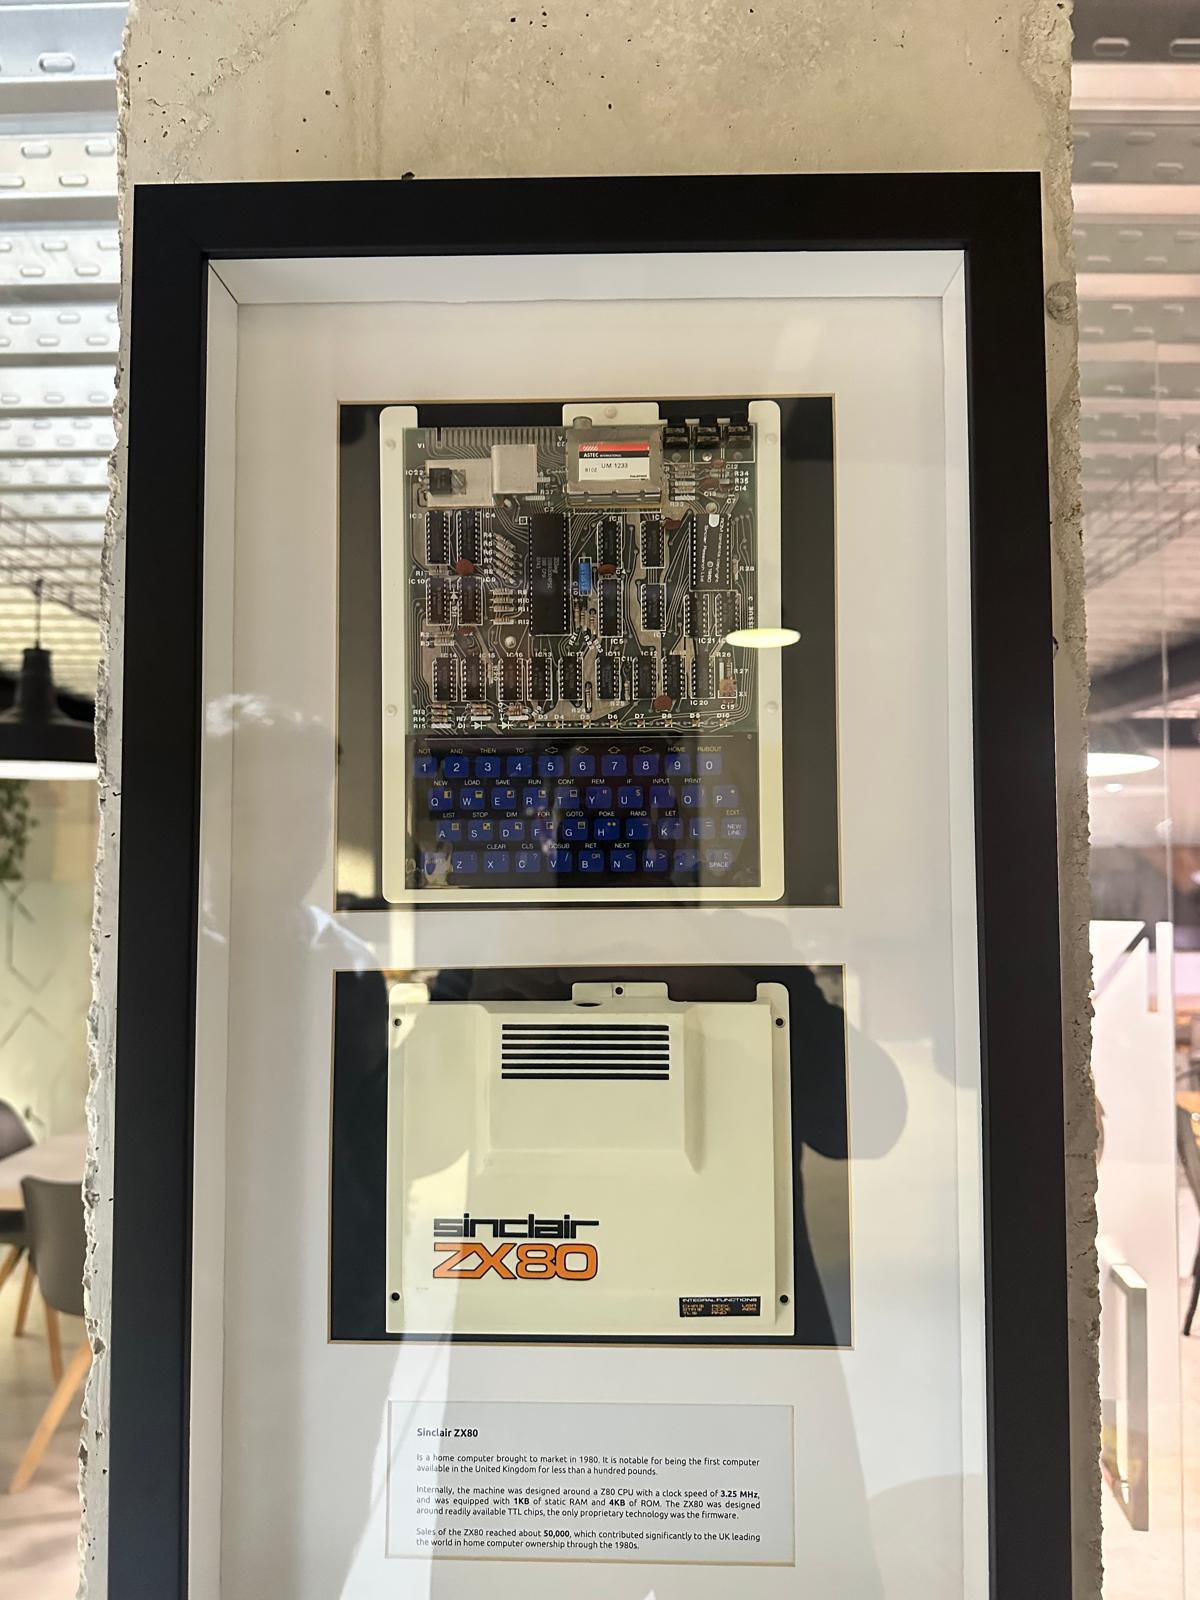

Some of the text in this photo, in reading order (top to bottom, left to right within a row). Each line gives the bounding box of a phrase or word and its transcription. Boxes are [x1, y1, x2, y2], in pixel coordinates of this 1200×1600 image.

[453, 763, 460, 772] 2
[484, 762, 491, 772] 3
[515, 763, 522, 771] 4
[547, 762, 554, 771] 5
[580, 762, 586, 770] 6
[612, 762, 618, 770] 7
[642, 761, 649, 770] 8
[674, 761, 680, 770] 9
[431, 796, 628, 806] Q W E R U
[471, 830, 478, 838] S
[565, 828, 572, 837] G
[597, 828, 604, 836] H
[582, 860, 588, 868] B
[433, 1213, 599, 1238] sinclair
[433, 1242, 598, 1281] ZX80
[417, 1428, 478, 1438] Sinclair ZX80
[457, 1455, 494, 1464] computer
[496, 1454, 528, 1464] brought
[540, 1456, 568, 1464] market
[618, 1456, 649, 1465] notable
[650, 1456, 663, 1465] for
[664, 1457, 687, 1467] being
[688, 1458, 702, 1466] the
[704, 1457, 720, 1466] first
[722, 1459, 760, 1467] computer
[416, 1464, 450, 1473] available
[460, 1465, 474, 1473] the
[475, 1465, 501, 1473] United
[502, 1465, 537, 1475] Kingdom
[538, 1465, 550, 1474] for
[551, 1465, 567, 1474] less
[568, 1466, 586, 1474] than
[593, 1466, 626, 1475] hundred
[457, 1486, 471, 1494] the
[472, 1486, 505, 1495] machine
[525, 1486, 561, 1497] designed
[562, 1487, 591, 1496] around
[600, 1488, 616, 1496] Z80
[617, 1488, 634, 1496] CPU
[635, 1489, 654, 1497] with
[662, 1489, 682, 1498] clock
[683, 1489, 708, 1499] speed
[709, 1489, 719, 1498] of
[720, 1490, 738, 1498] 3.25
[453, 1497, 489, 1506] equipped
[533, 1497, 541, 1505] of
[591, 1498, 606, 1506] and
[609, 1499, 626, 1507] 4KB
[628, 1498, 637, 1507] of
[665, 1500, 680, 1508] The
[683, 1500, 704, 1508] ZX80
[725, 1500, 760, 1510] designed
[416, 1507, 444, 1515] around
[445, 1507, 471, 1517] readily
[472, 1508, 506, 1516] available
[508, 1508, 522, 1516] TTL
[547, 1508, 560, 1517] the
[562, 1508, 578, 1518] only
[580, 1508, 624, 1519] proprietary
[625, 1509, 669, 1520] technology
[686, 1511, 700, 1519] the
[416, 1528, 436, 1536] Sales
[437, 1527, 447, 1536] of
[448, 1528, 462, 1536] the
[464, 1528, 484, 1537] ZX80
[486, 1528, 517, 1537] reached
[518, 1529, 541, 1538] about
[574, 1530, 596, 1538] which
[598, 1531, 644, 1539] contributed
[645, 1530, 692, 1541] significantly
[704, 1532, 717, 1540] the
[732, 1533, 760, 1543] leading
[463, 1538, 485, 1547] home
[486, 1540, 524, 1549] computer
[525, 1540, 566, 1549] ownership
[566, 1540, 598, 1550] through
[599, 1541, 613, 1549] the
